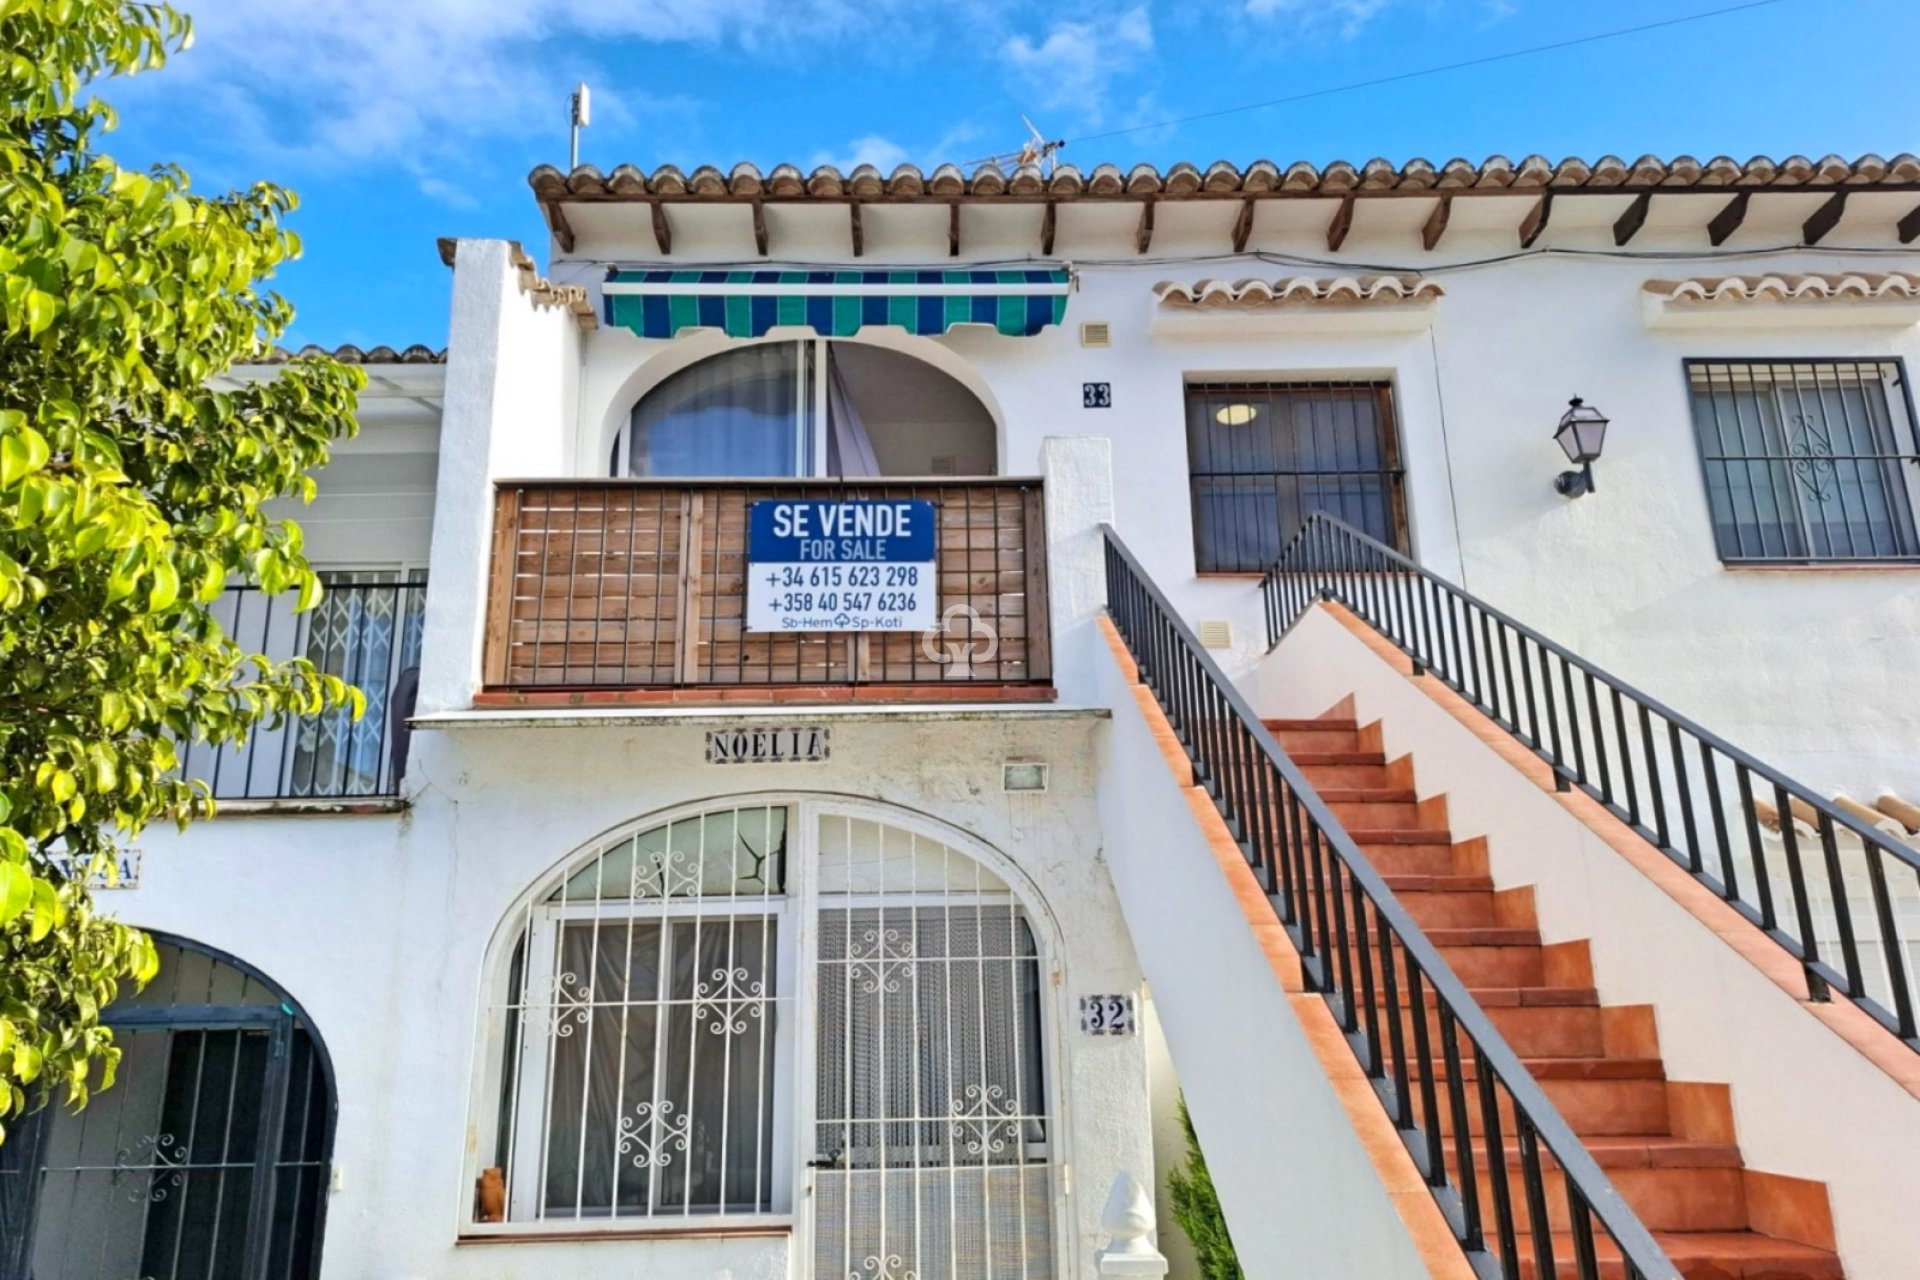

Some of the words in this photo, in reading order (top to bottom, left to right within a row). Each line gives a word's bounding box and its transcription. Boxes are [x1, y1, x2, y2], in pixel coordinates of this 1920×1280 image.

[1084, 384, 1110, 406] 33
[773, 504, 810, 538] SE
[818, 504, 912, 538] VENDE
[800, 539, 836, 561] FOR
[841, 539, 887, 561] SALE
[765, 566, 804, 587] +34
[810, 566, 842, 587] 615
[848, 566, 880, 587] 623
[886, 566, 918, 587] 298
[768, 592, 813, 612] +358
[818, 592, 838, 612] 40
[843, 592, 872, 612] 547
[877, 592, 917, 612] 6236
[781, 617, 833, 629] Sb-Hem
[852, 616, 903, 630] Sp-Koti
[714, 732, 823, 759] NOELIA
[1089, 1000, 1125, 1030] 32
